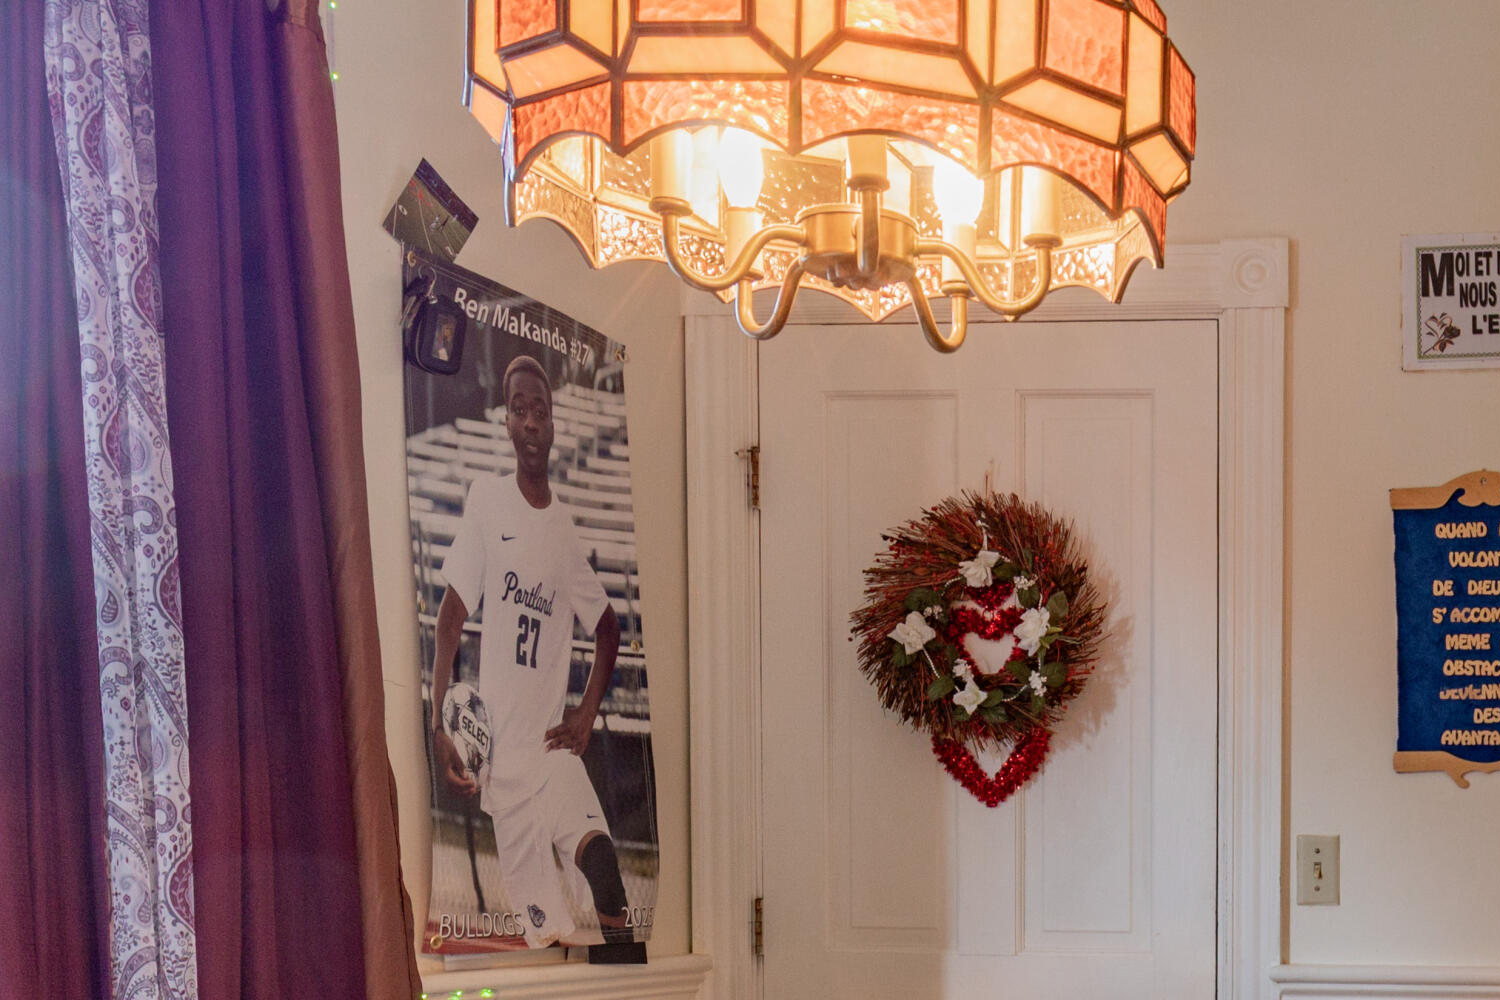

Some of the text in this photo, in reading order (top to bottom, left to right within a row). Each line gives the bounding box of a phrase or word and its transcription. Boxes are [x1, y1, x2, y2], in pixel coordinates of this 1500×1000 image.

[1421, 252, 1470, 297] MOI
[1475, 251, 1493, 276] ET
[1460, 281, 1497, 308] NOUS
[492, 304, 568, 355] Makanda
[1435, 522, 1488, 539] QUAND
[502, 571, 556, 617] Portland
[1433, 580, 1454, 597] DE
[516, 614, 541, 669] 27
[1445, 633, 1491, 650] MEME
[462, 715, 489, 751] SELECT
[440, 913, 525, 938] BULLDOGS
